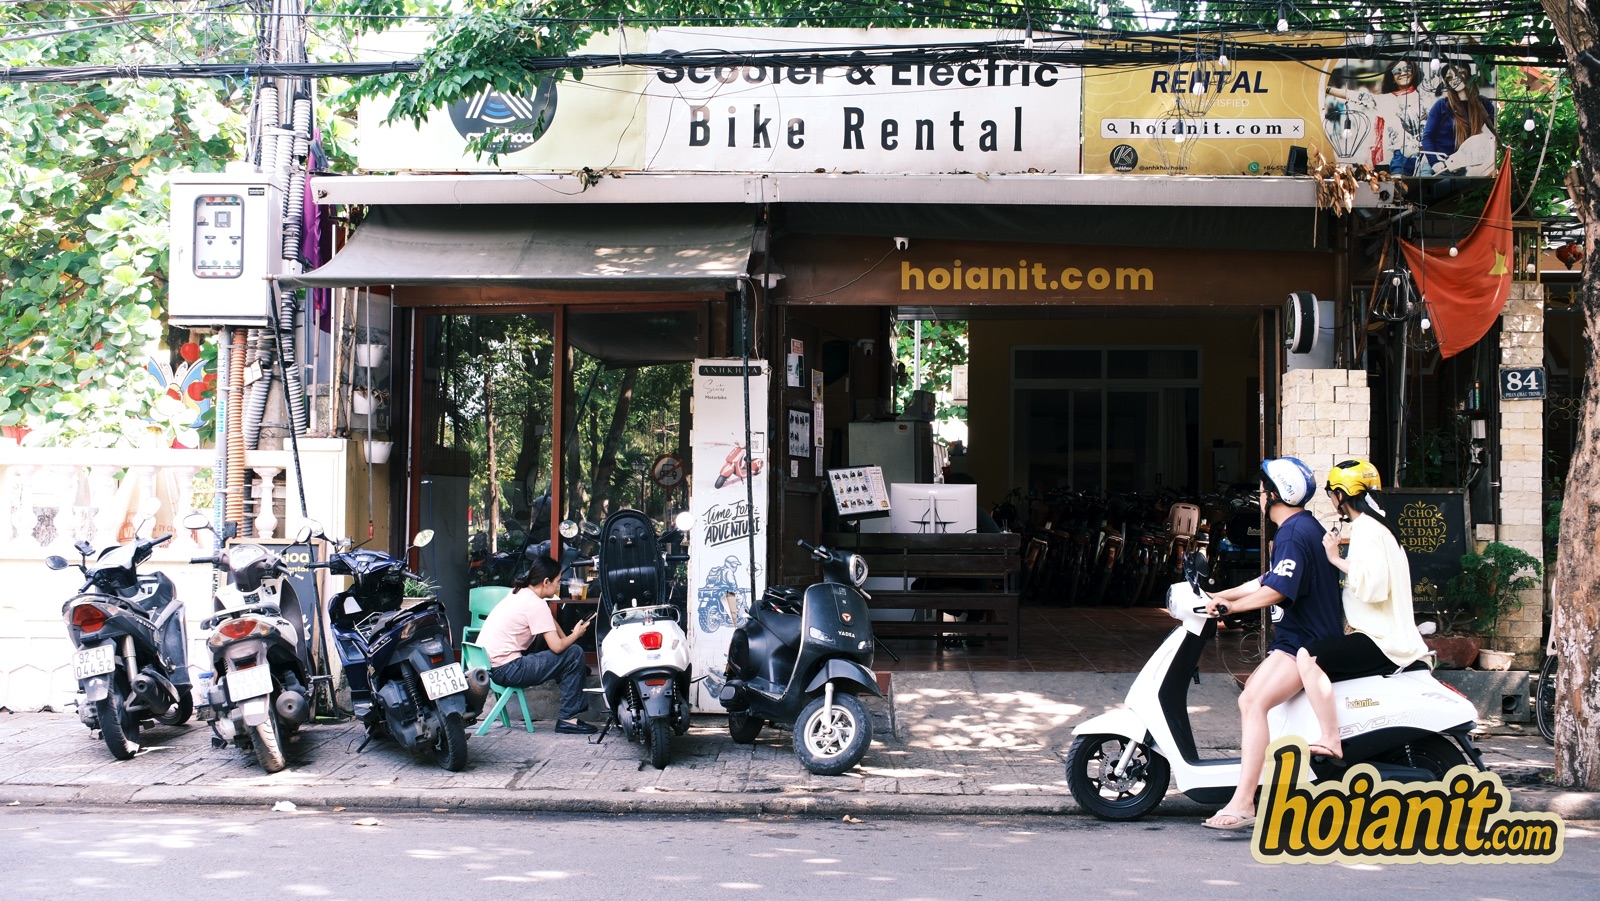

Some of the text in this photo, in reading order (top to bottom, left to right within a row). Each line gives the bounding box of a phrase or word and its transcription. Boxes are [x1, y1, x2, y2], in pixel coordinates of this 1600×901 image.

[1150, 70, 1269, 94] RENTAL
[688, 103, 1023, 153] Bike Rental
[901, 259, 1154, 291] hoianit.com
[1506, 370, 1539, 391] 84
[701, 503, 732, 525] Time
[1404, 517, 1438, 527] THUÊ
[1408, 509, 1433, 518] CHO
[1400, 528, 1441, 538] XE ĐẠP
[1272, 558, 1297, 578] 42
[837, 630, 856, 639] YADEA
[76, 659, 113, 678] 044.52
[429, 677, 466, 698] 421.84
